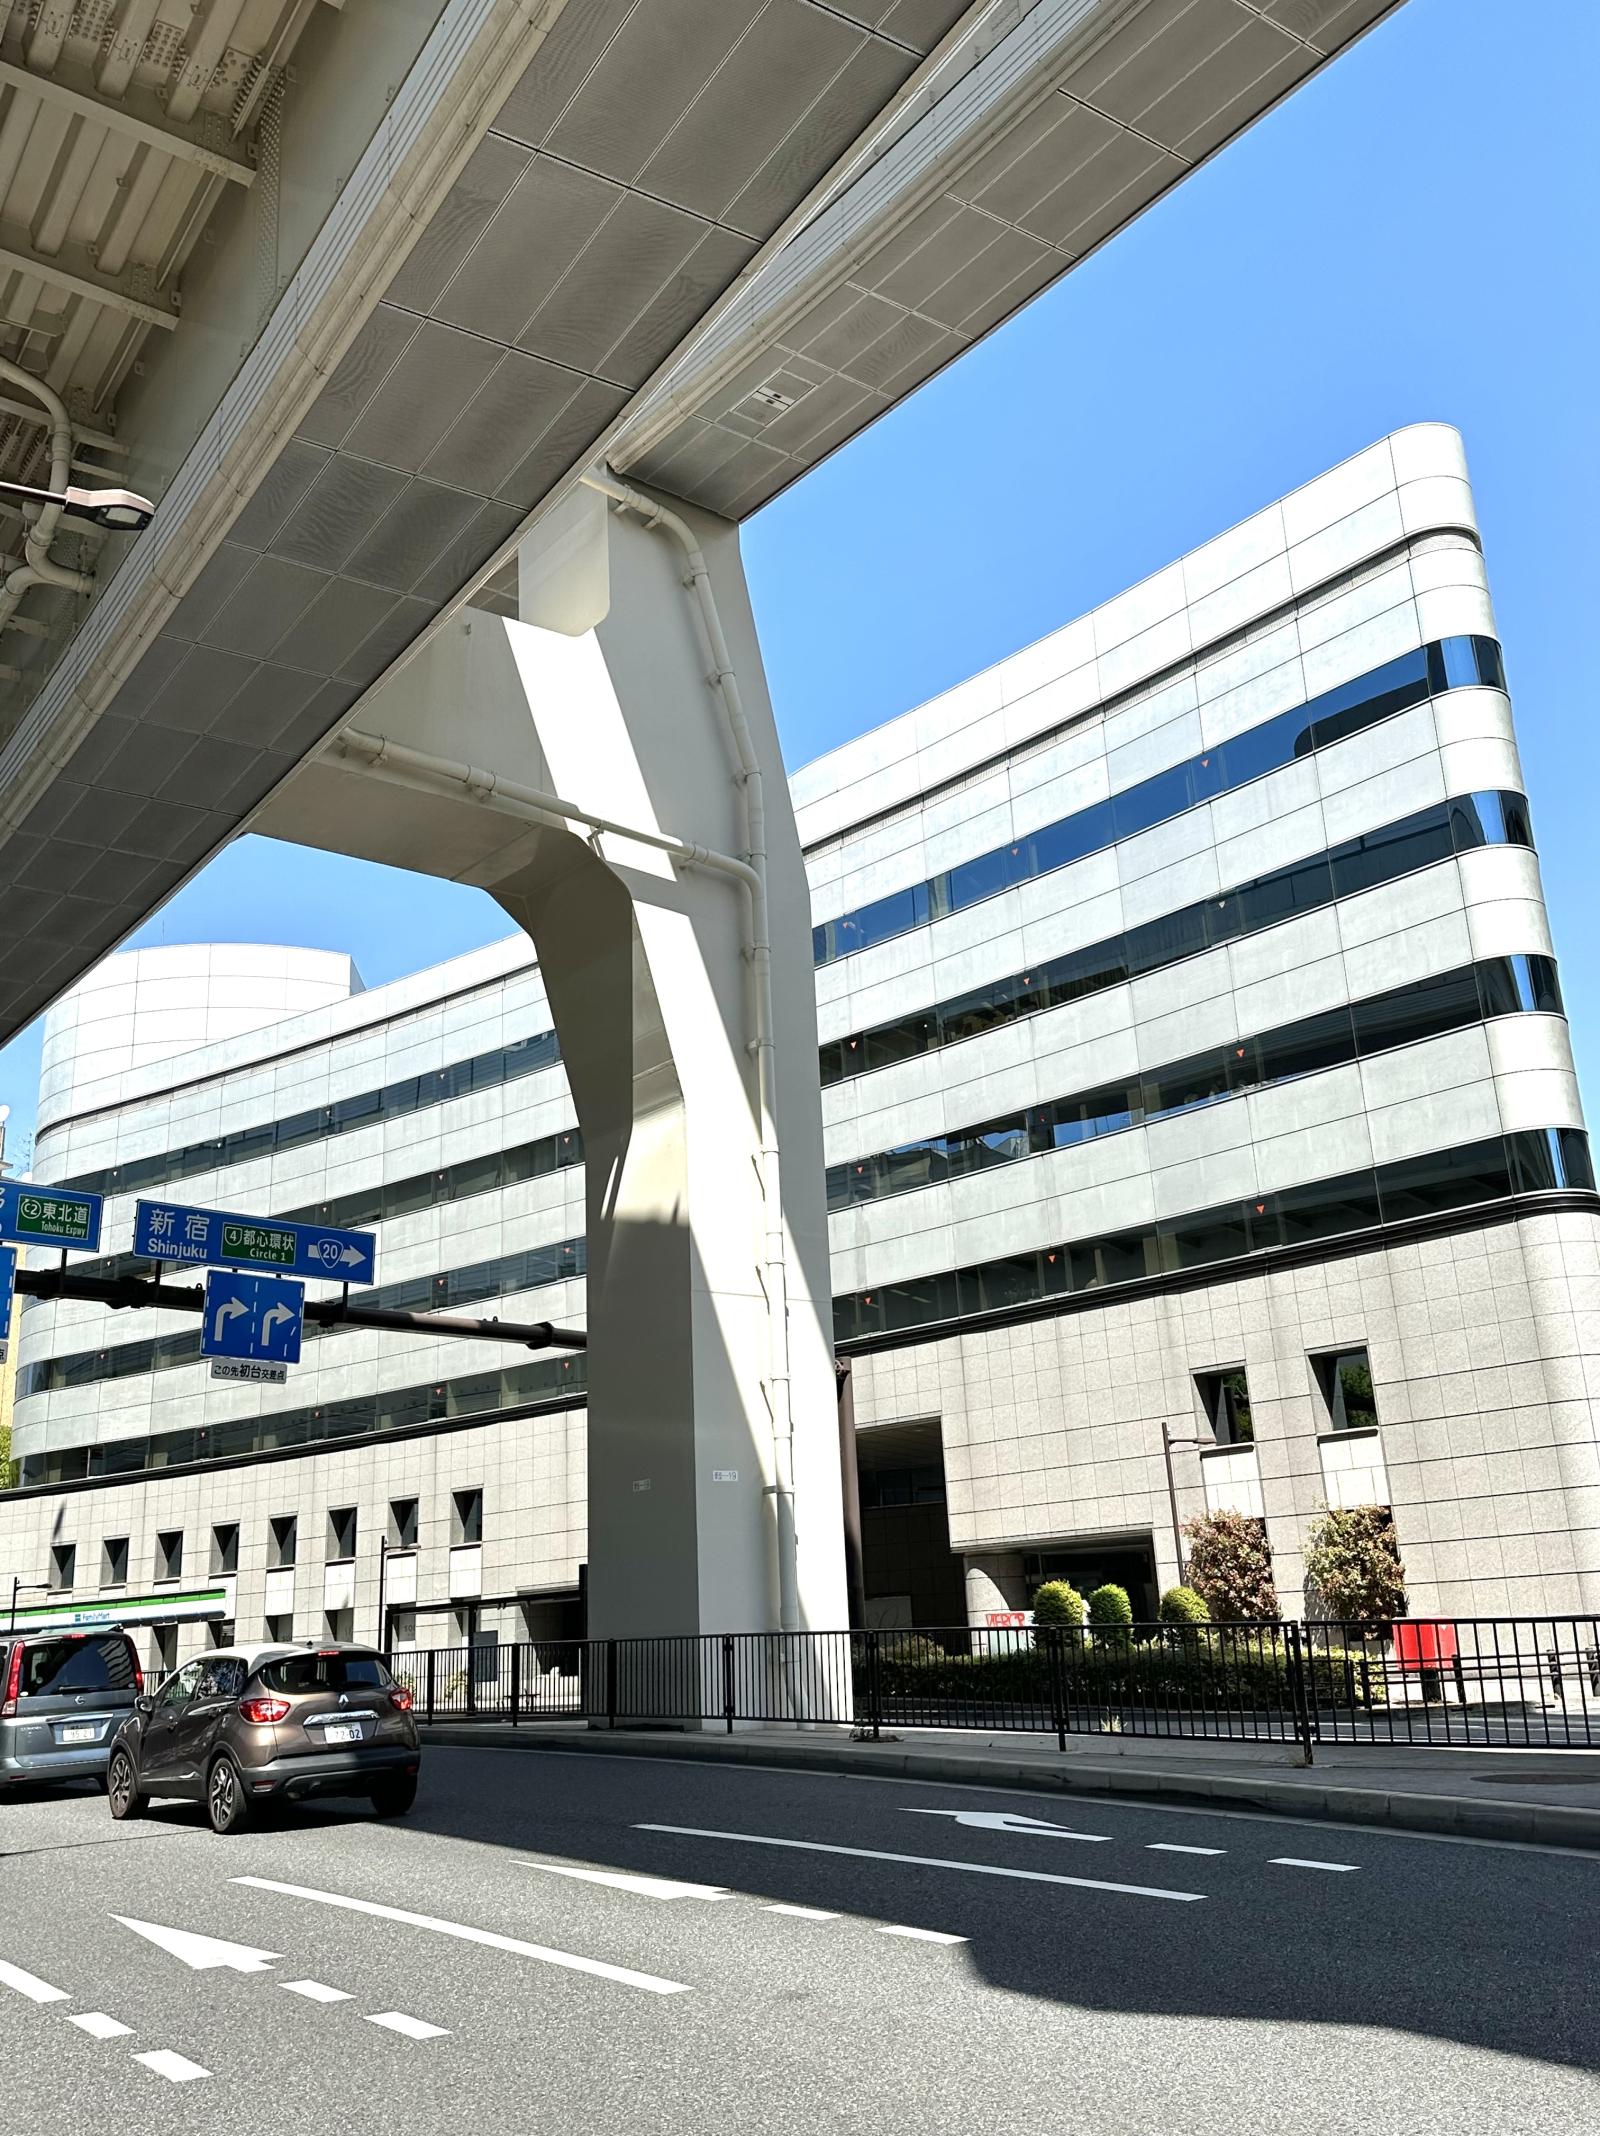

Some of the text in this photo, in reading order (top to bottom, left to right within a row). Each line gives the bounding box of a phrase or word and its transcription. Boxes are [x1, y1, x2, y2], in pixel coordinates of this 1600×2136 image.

[42, 1202, 89, 1224] 東北道
[41, 1221, 64, 1233] Tohoku
[149, 1208, 210, 1241] 新宿
[148, 1238, 207, 1259] Shinjuku
[229, 1229, 295, 1251] 4 都心環状
[250, 1248, 286, 1261] Circle 1
[323, 1243, 338, 1260] 20
[214, 1363, 285, 1381] この先初台交差点
[82, 1612, 110, 1621] FamilyMart
